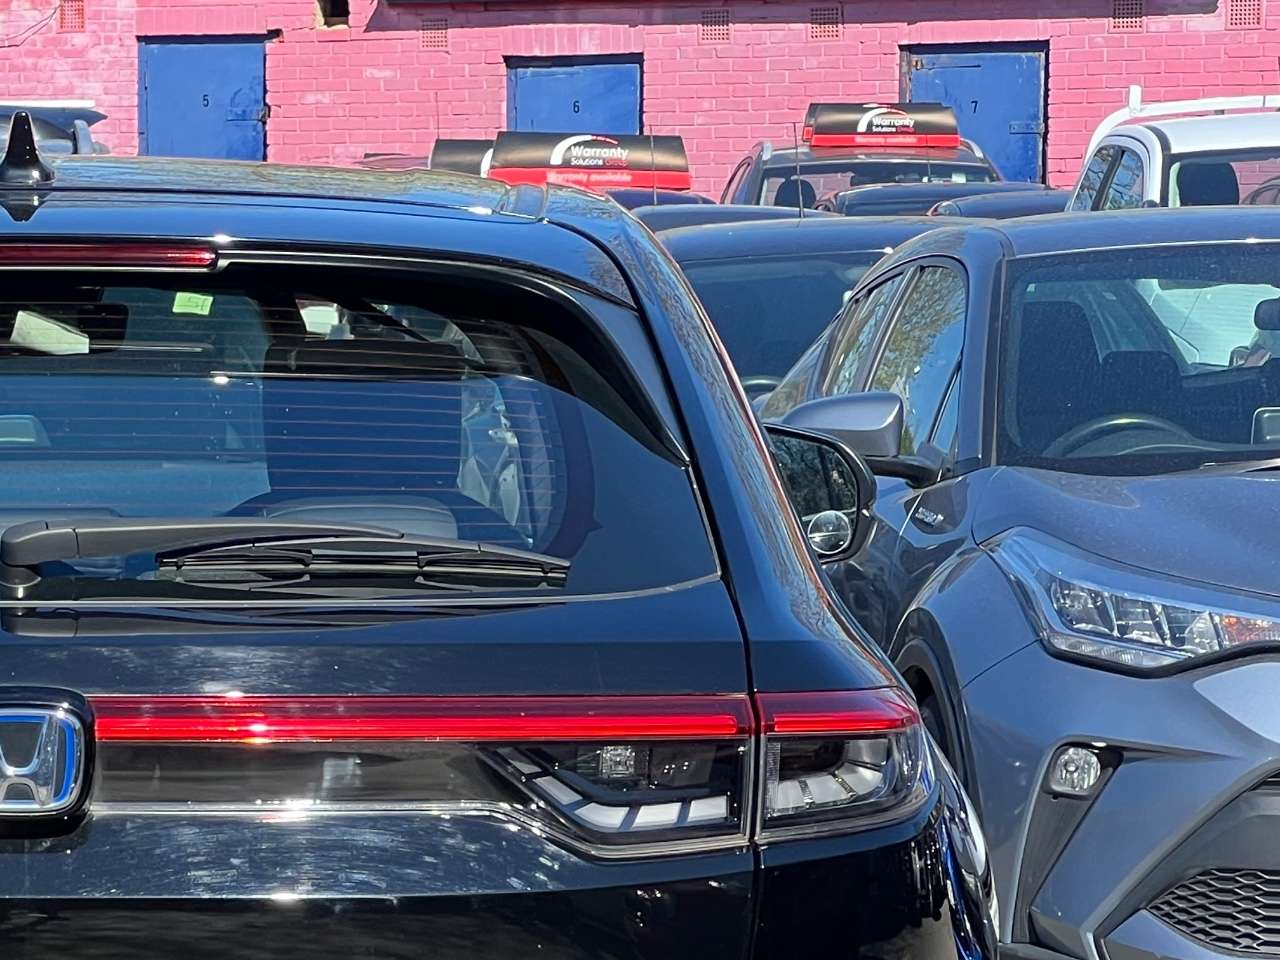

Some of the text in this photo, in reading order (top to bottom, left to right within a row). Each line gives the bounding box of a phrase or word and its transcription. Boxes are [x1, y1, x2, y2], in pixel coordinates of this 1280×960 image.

[202, 94, 209, 107] 5
[573, 100, 580, 113] 6
[970, 100, 978, 113] 7
[570, 145, 629, 160] Warranty
[570, 157, 604, 166] Solutions
